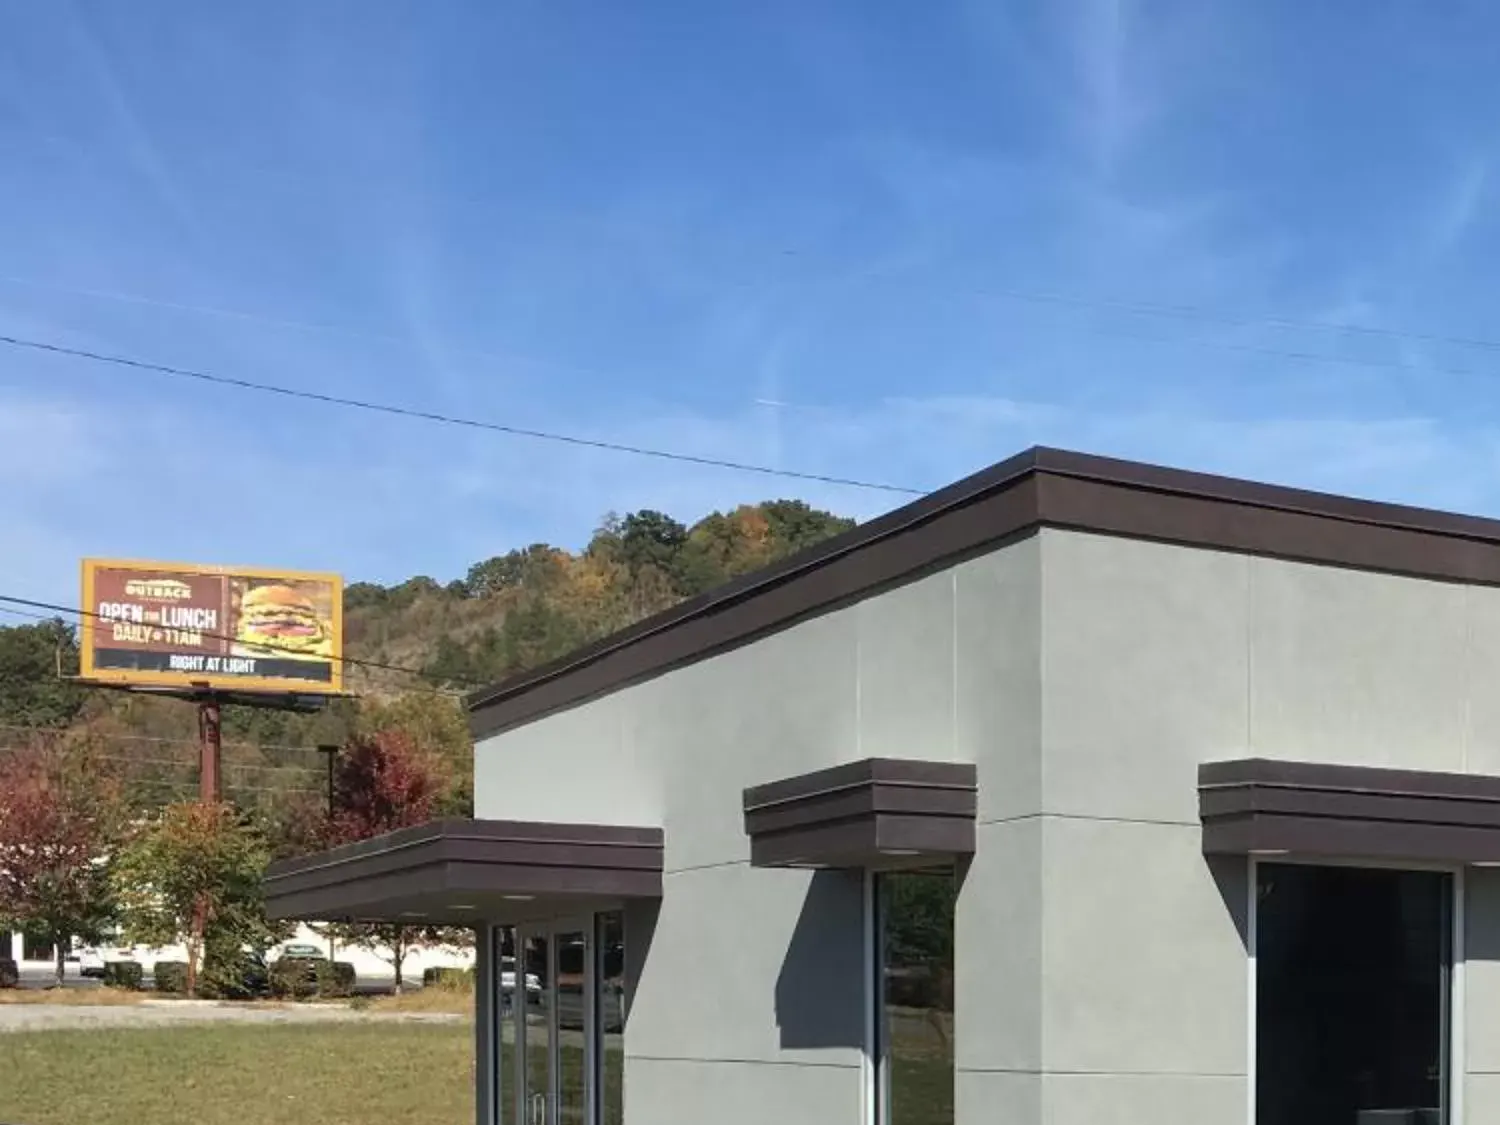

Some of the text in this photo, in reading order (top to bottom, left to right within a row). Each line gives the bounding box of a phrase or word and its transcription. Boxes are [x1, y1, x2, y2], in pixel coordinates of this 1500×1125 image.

[125, 584, 192, 599] OUTBACK
[99, 602, 143, 622] OPEN
[161, 607, 217, 629] LUNCH
[113, 622, 152, 644] DAILY
[170, 654, 256, 673] RIGHT AT LIGHT
